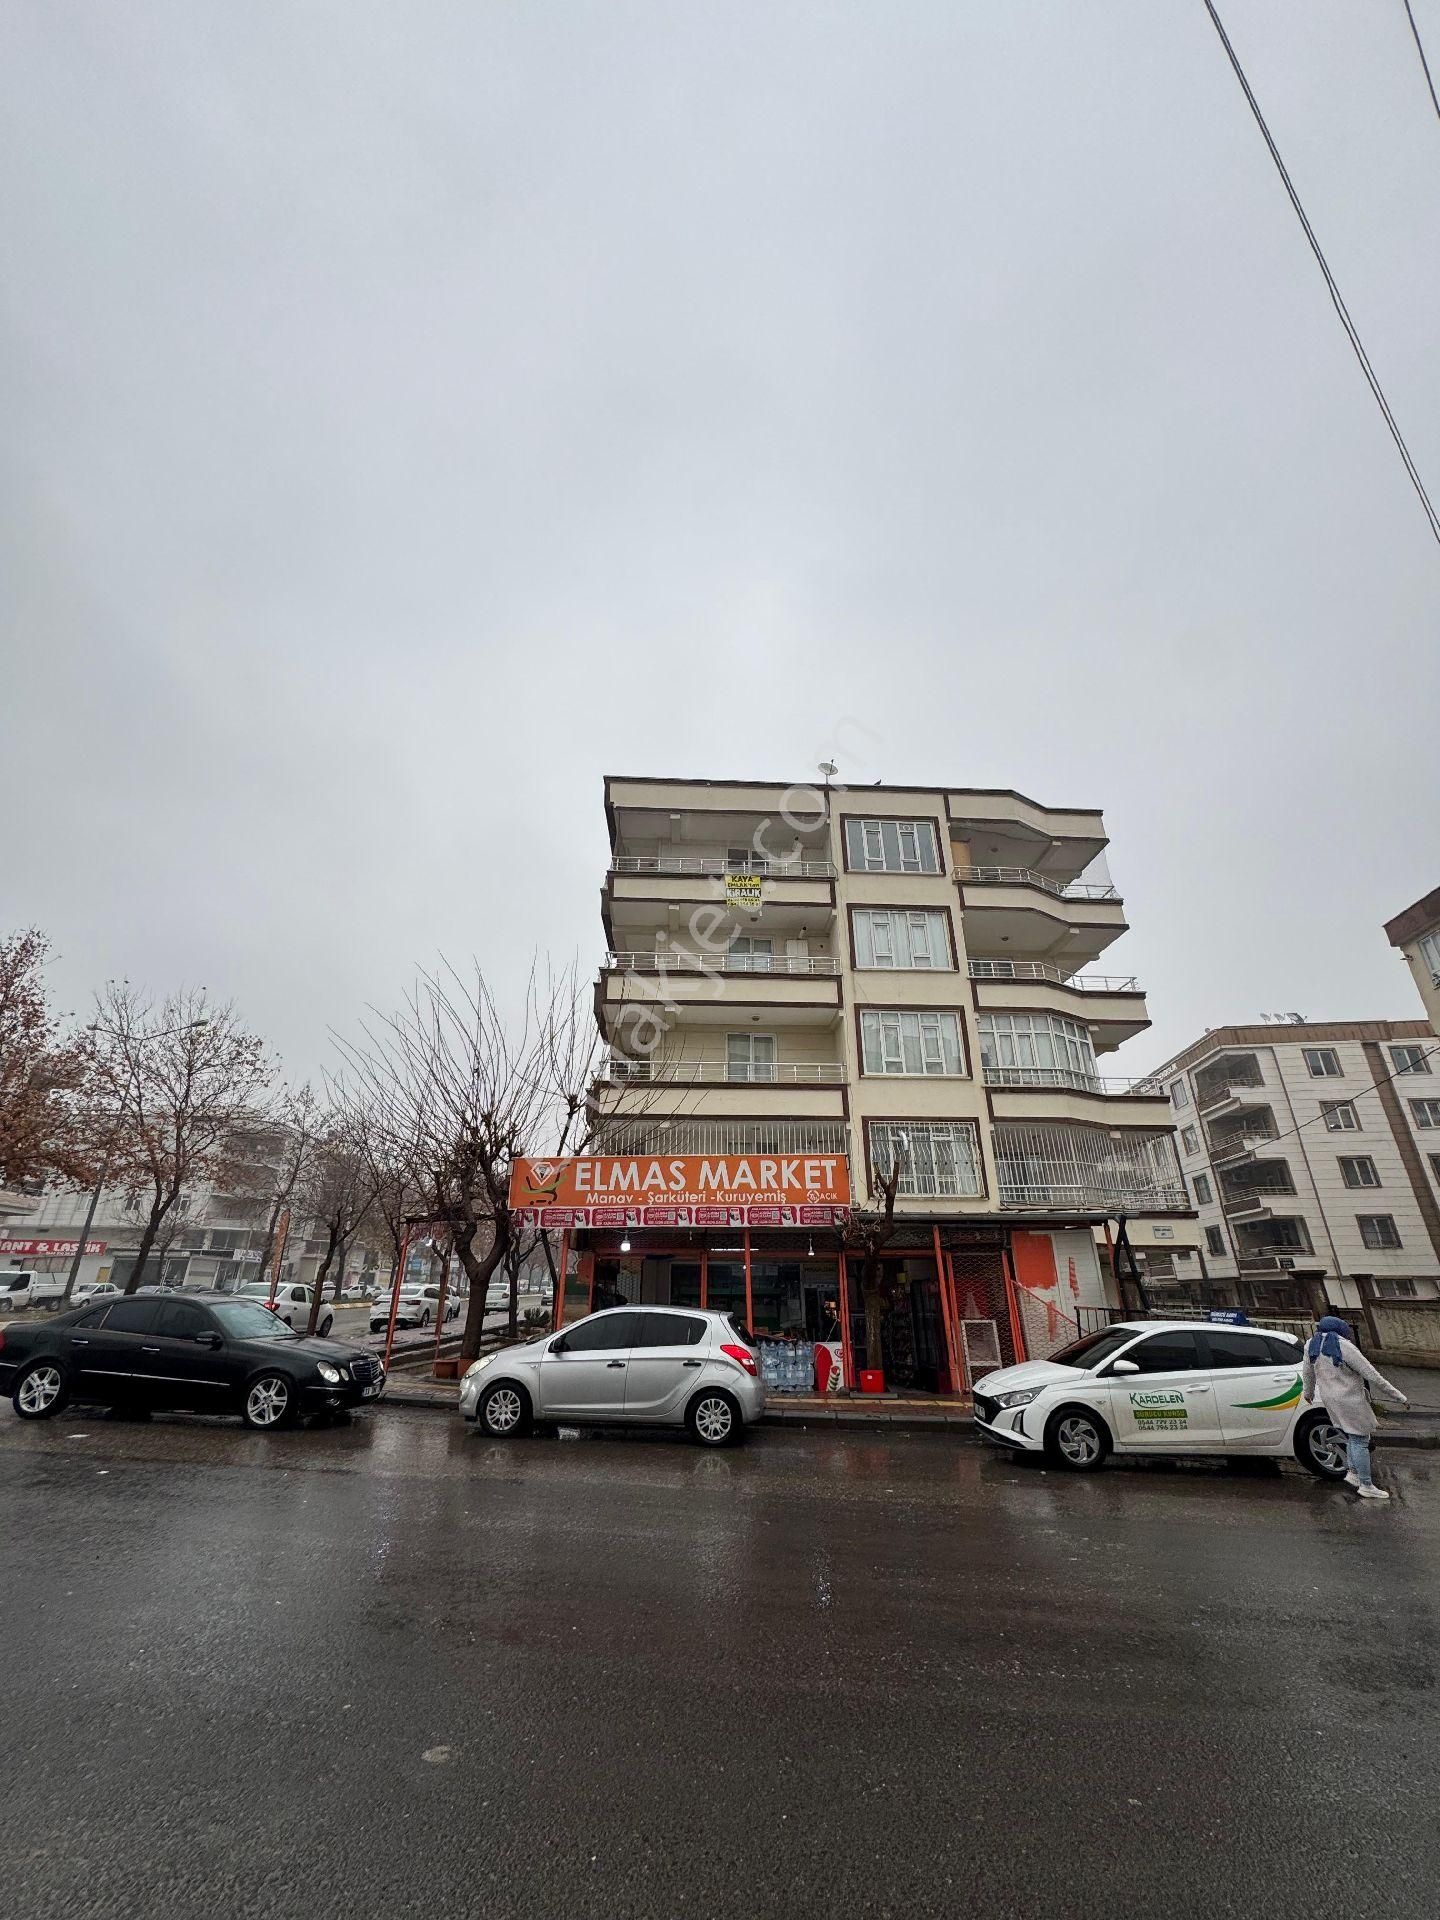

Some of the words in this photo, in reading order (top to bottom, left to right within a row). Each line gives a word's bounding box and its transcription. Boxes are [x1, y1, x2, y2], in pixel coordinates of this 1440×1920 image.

[574, 1159, 686, 1192] ELMAS
[698, 1159, 837, 1191] MARKET
[585, 1191, 634, 1204] Manav
[647, 1190, 706, 1205] Şarküteri
[0, 1240, 33, 1251] ANT
[36, 1242, 50, 1252] &
[1129, 1392, 1185, 1406] KARDELEN
